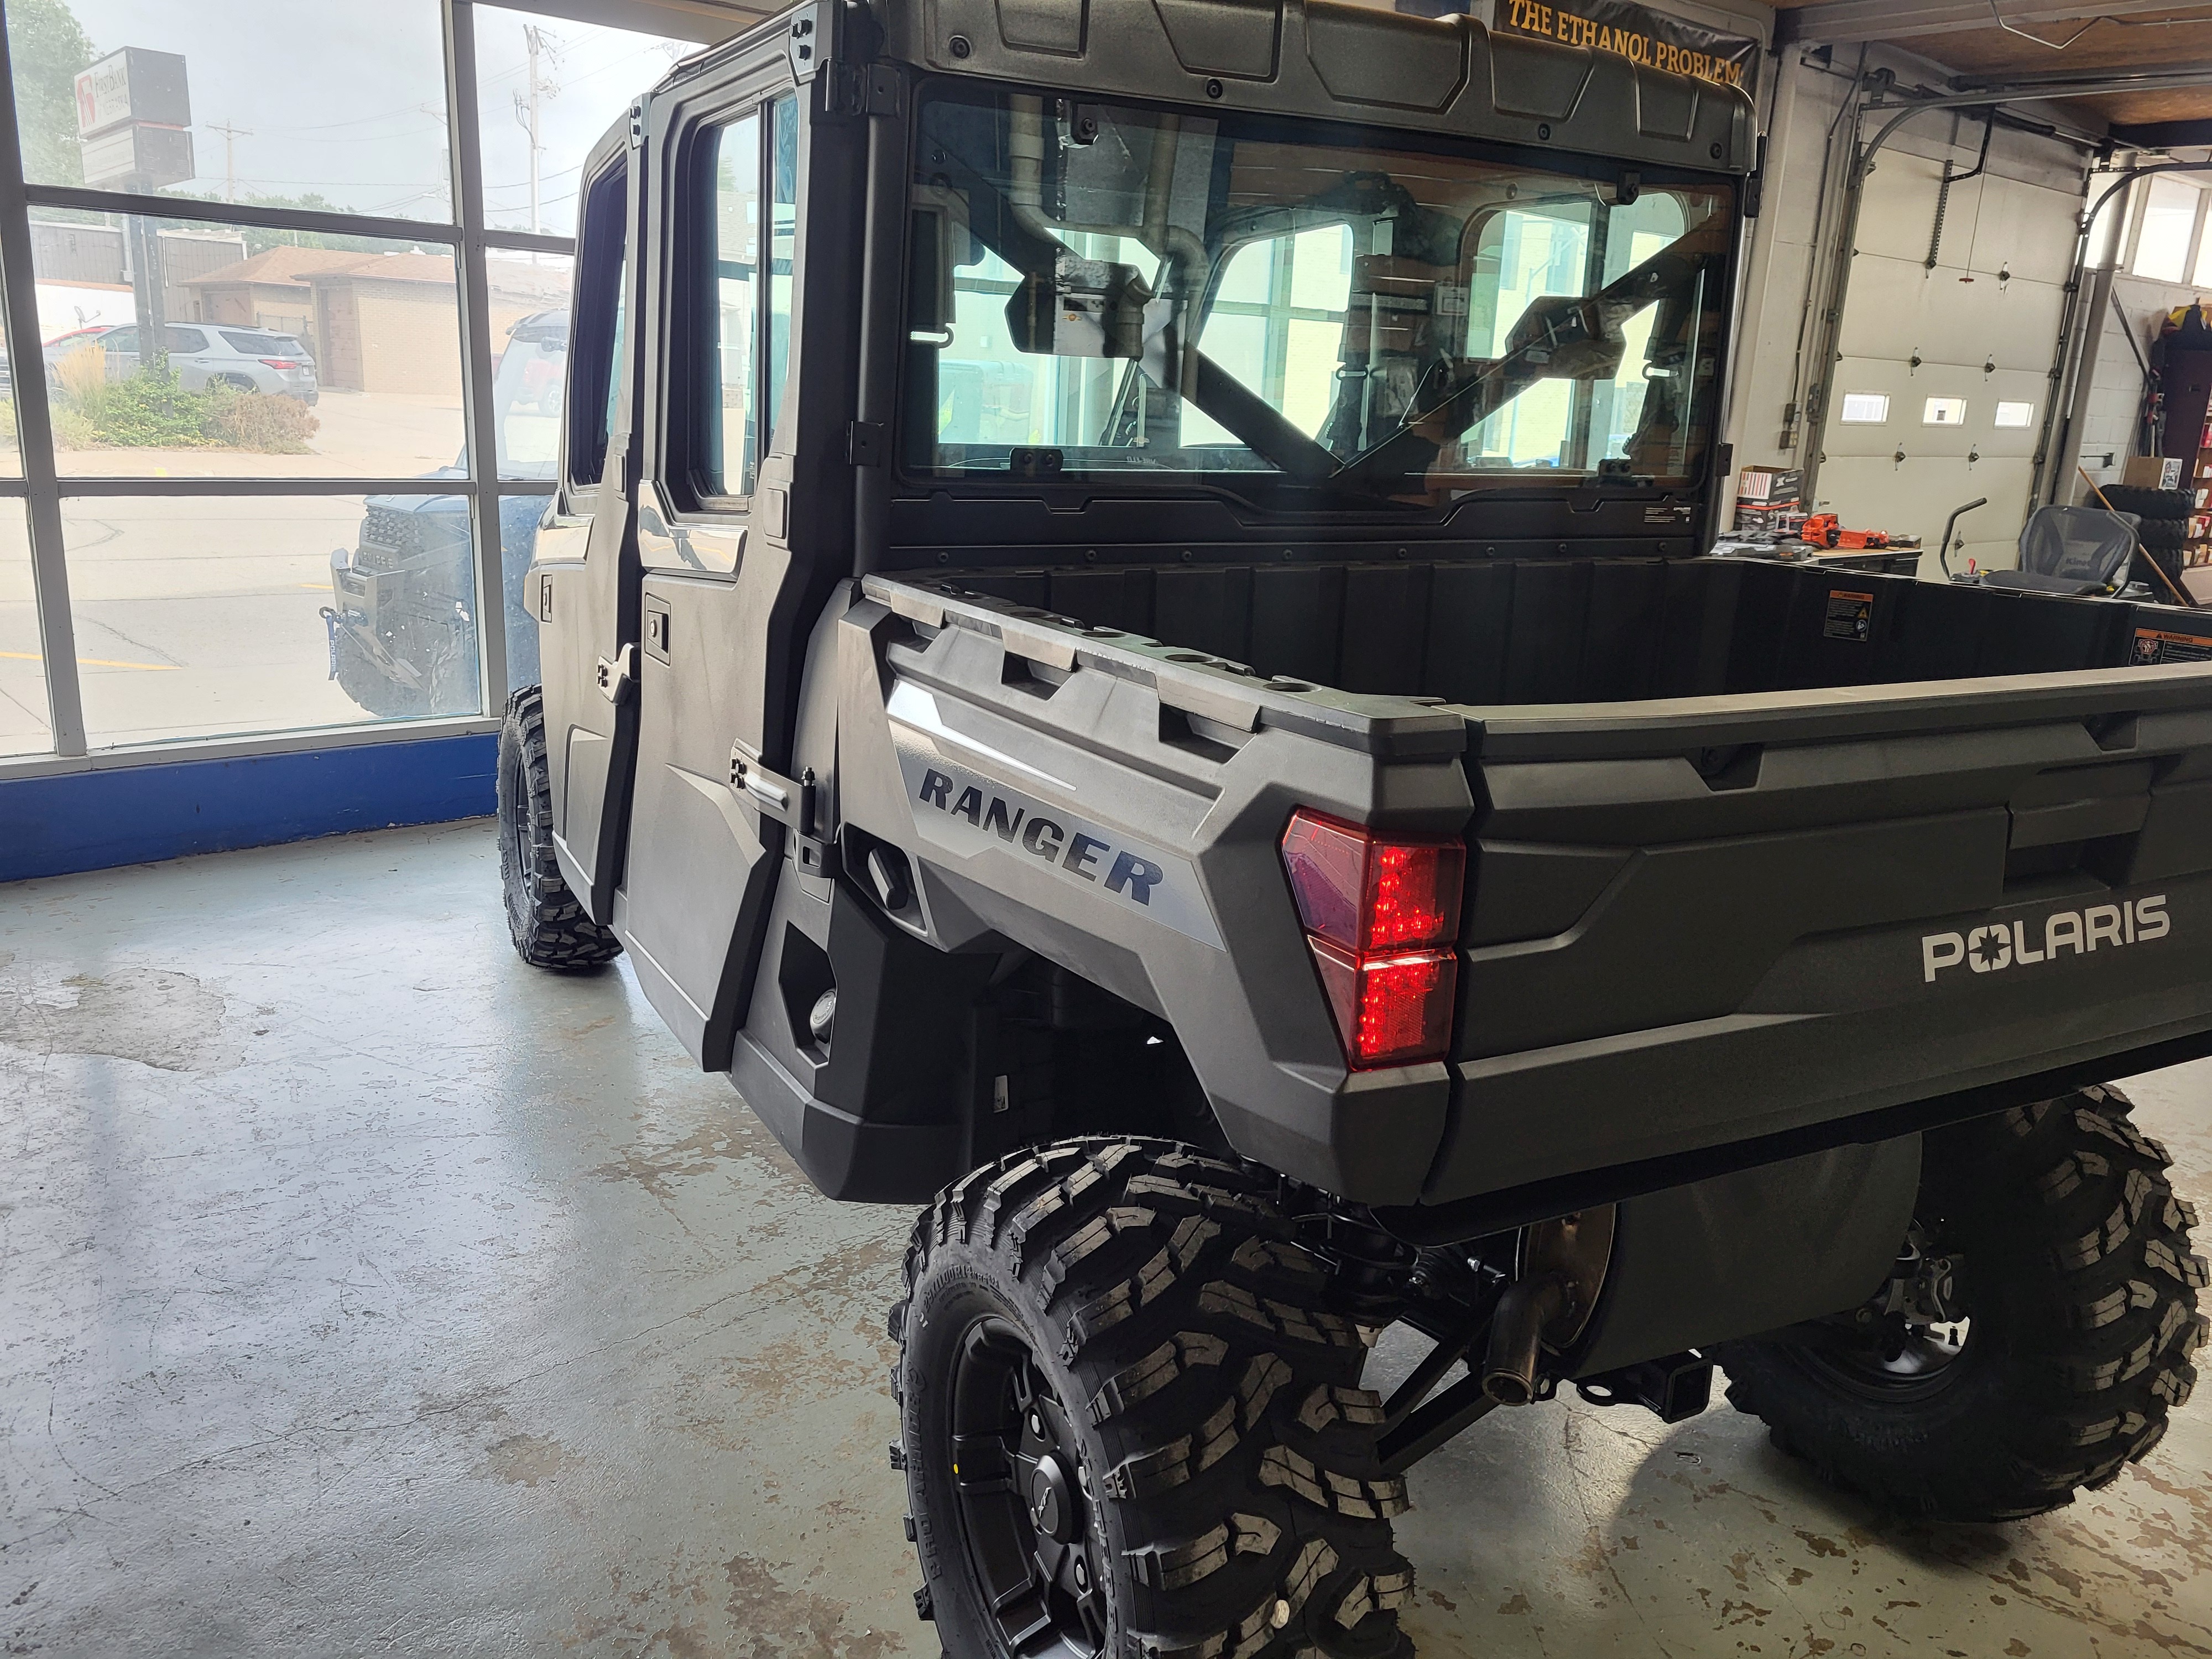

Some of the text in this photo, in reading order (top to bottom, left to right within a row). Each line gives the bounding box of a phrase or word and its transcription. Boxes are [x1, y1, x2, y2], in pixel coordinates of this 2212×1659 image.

[1509, 0, 1552, 35] THE
[1557, 12, 1651, 66] ETHANOL
[2163, 633, 2193, 643] WARNING
[919, 768, 1164, 906] RANGER
[1922, 894, 2170, 983] POLARIS
